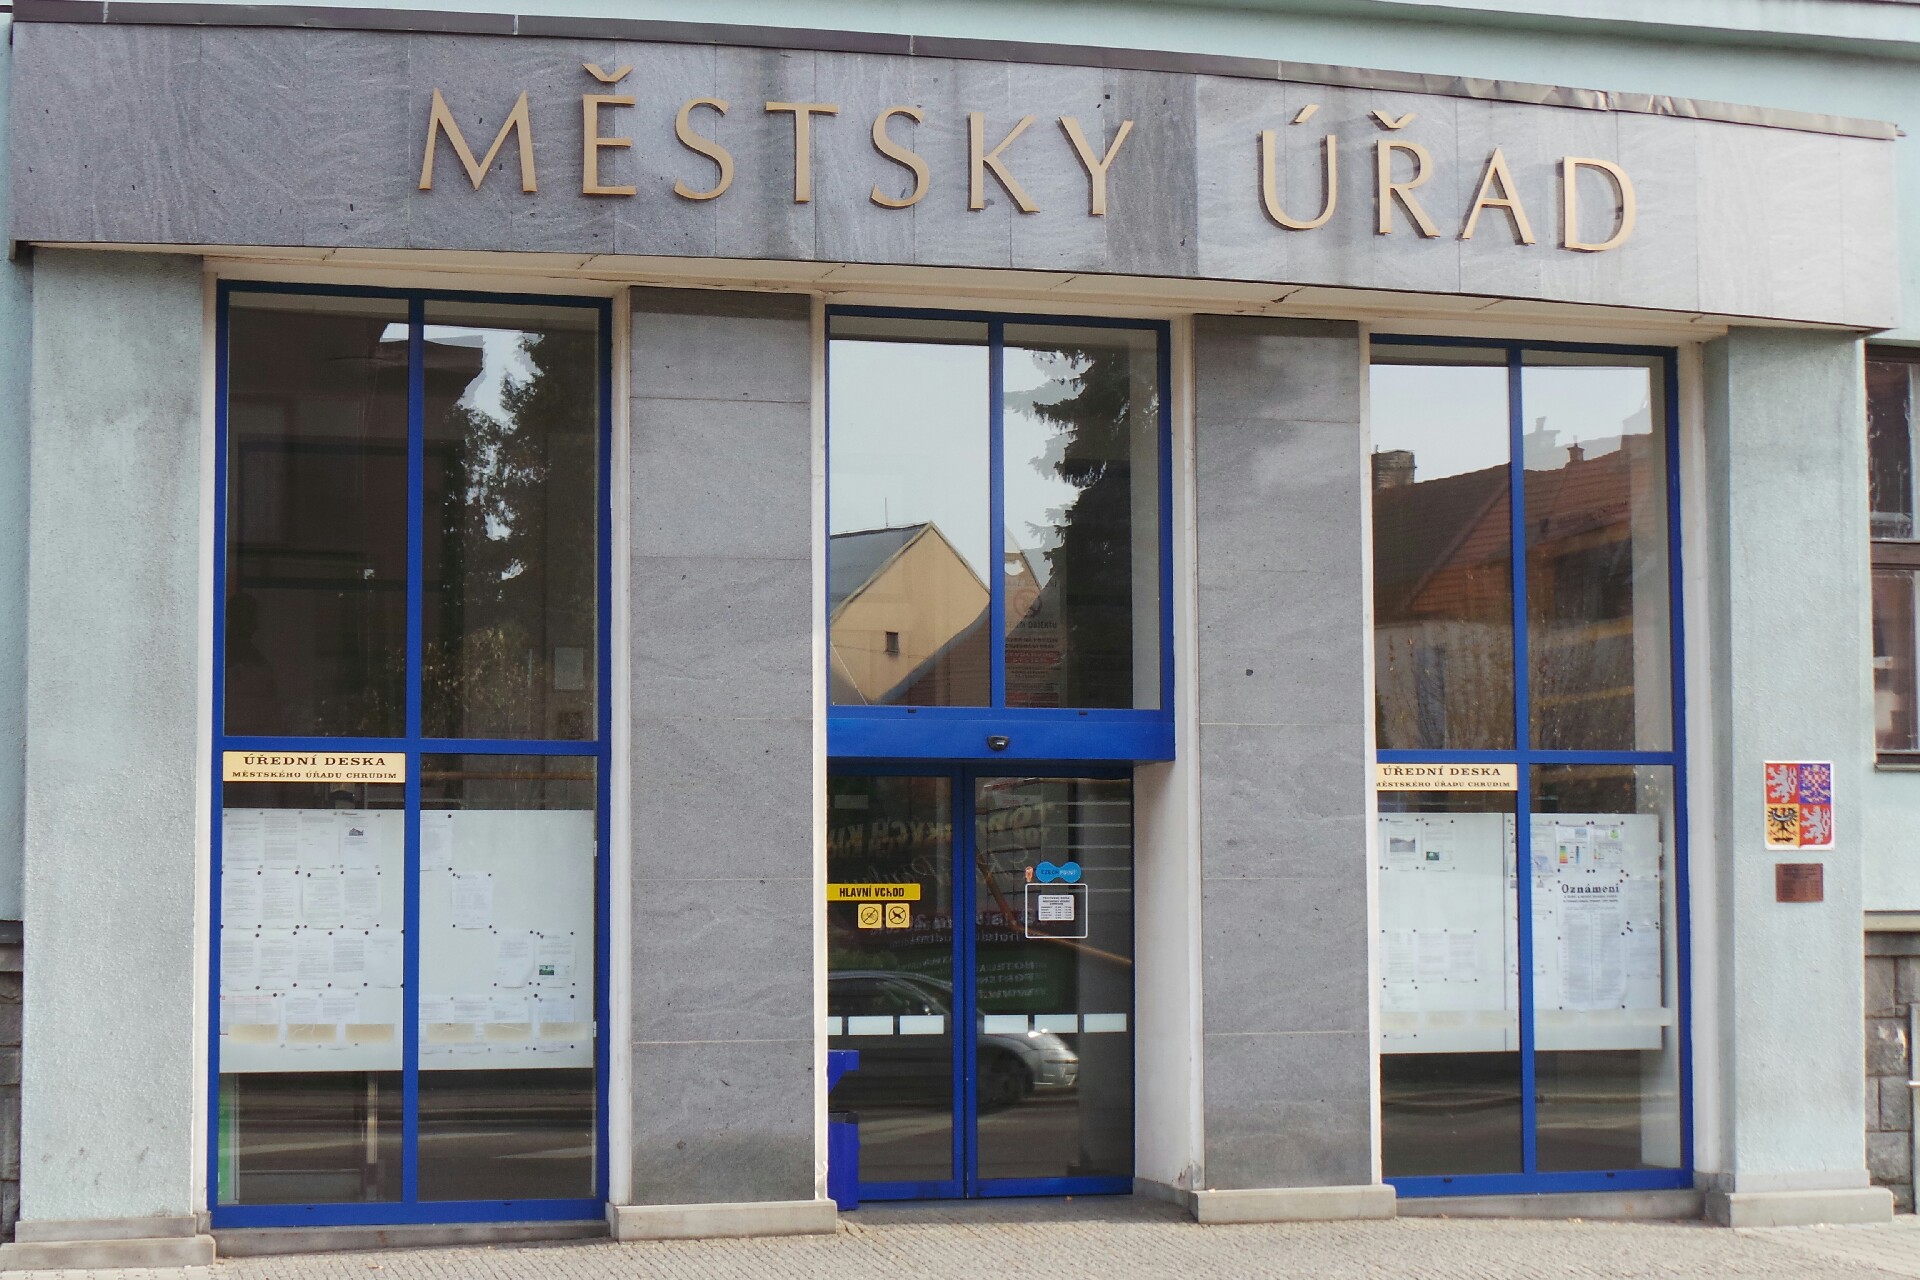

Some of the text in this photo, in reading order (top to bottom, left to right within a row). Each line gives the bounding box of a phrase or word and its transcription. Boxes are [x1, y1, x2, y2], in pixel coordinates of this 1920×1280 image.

[418, 63, 1636, 251] MĚSTSKY ÚŘAD
[243, 753, 386, 766] ÚŘEDNÍ DESKA
[232, 770, 301, 778] MĚSTSKÉHO
[305, 770, 342, 779] ÚŘADU
[1383, 765, 1501, 776] ÚŘEDNÍ DESKA
[839, 885, 872, 897] HLAVNÍ
[1561, 883, 1620, 894] Oznámení
